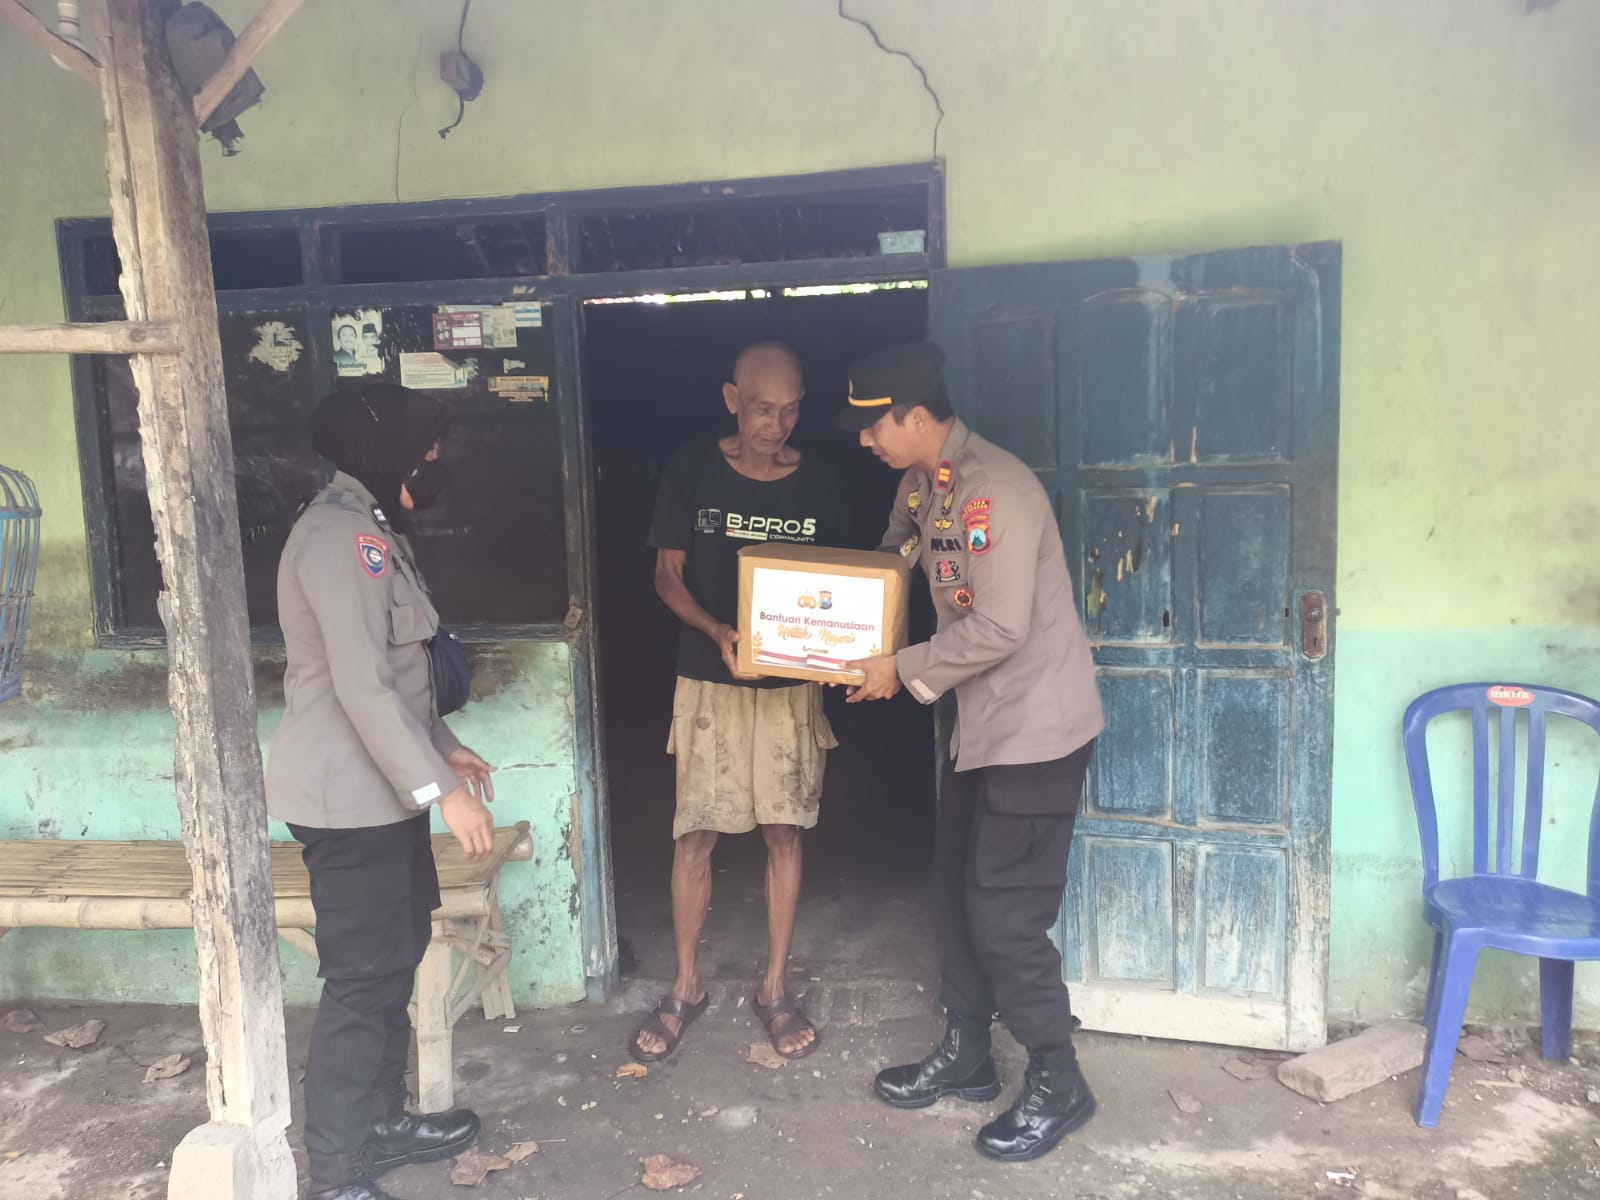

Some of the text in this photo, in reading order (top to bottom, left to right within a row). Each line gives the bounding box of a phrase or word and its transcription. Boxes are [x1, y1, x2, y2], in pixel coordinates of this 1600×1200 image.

[338, 361, 368, 369] Bambang
[726, 513, 816, 535] B-PRO5
[769, 534, 815, 542] COMMUNITY
[759, 611, 875, 632] Bantuan Kemanusiaan
